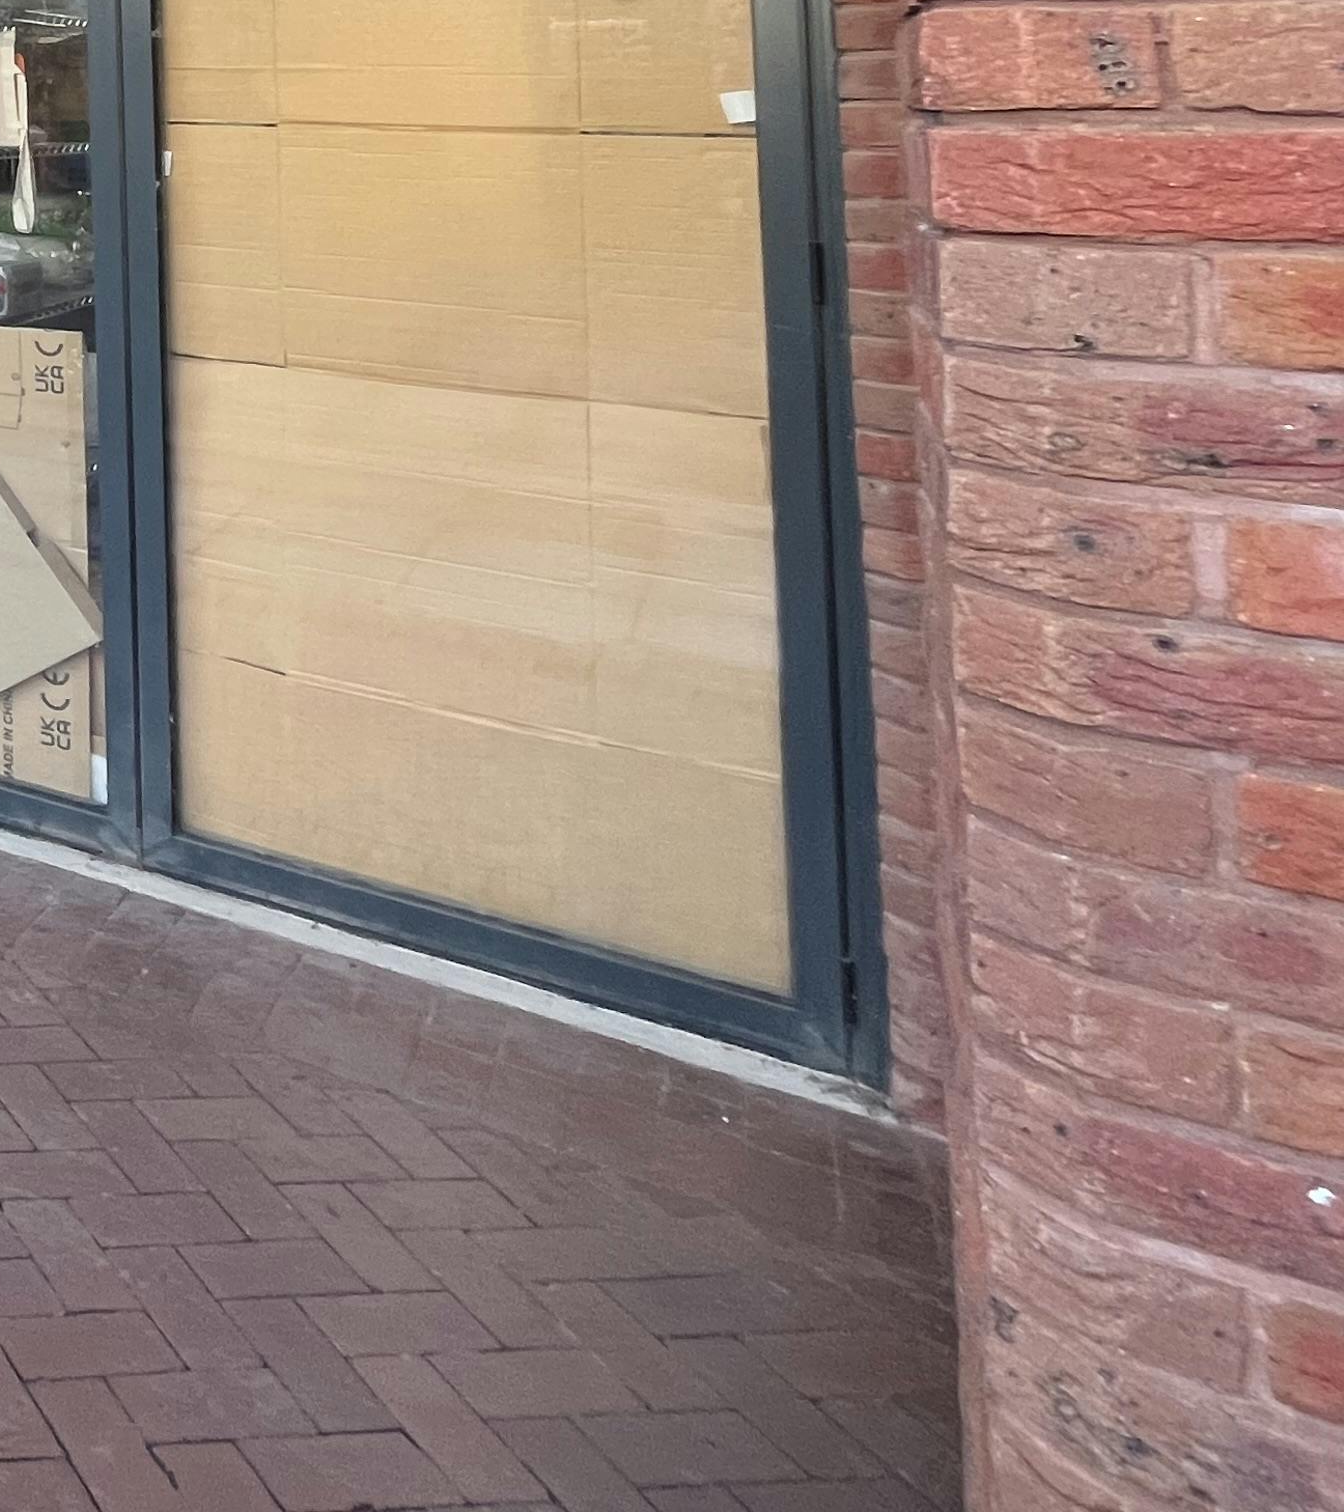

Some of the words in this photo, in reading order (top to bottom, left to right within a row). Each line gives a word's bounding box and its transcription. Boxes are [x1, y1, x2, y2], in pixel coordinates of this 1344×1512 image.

[35, 364, 49, 393] UK
[51, 365, 64, 394] CA
[3, 727, 14, 742] IN
[40, 717, 55, 746] UK
[56, 720, 71, 751] CA
